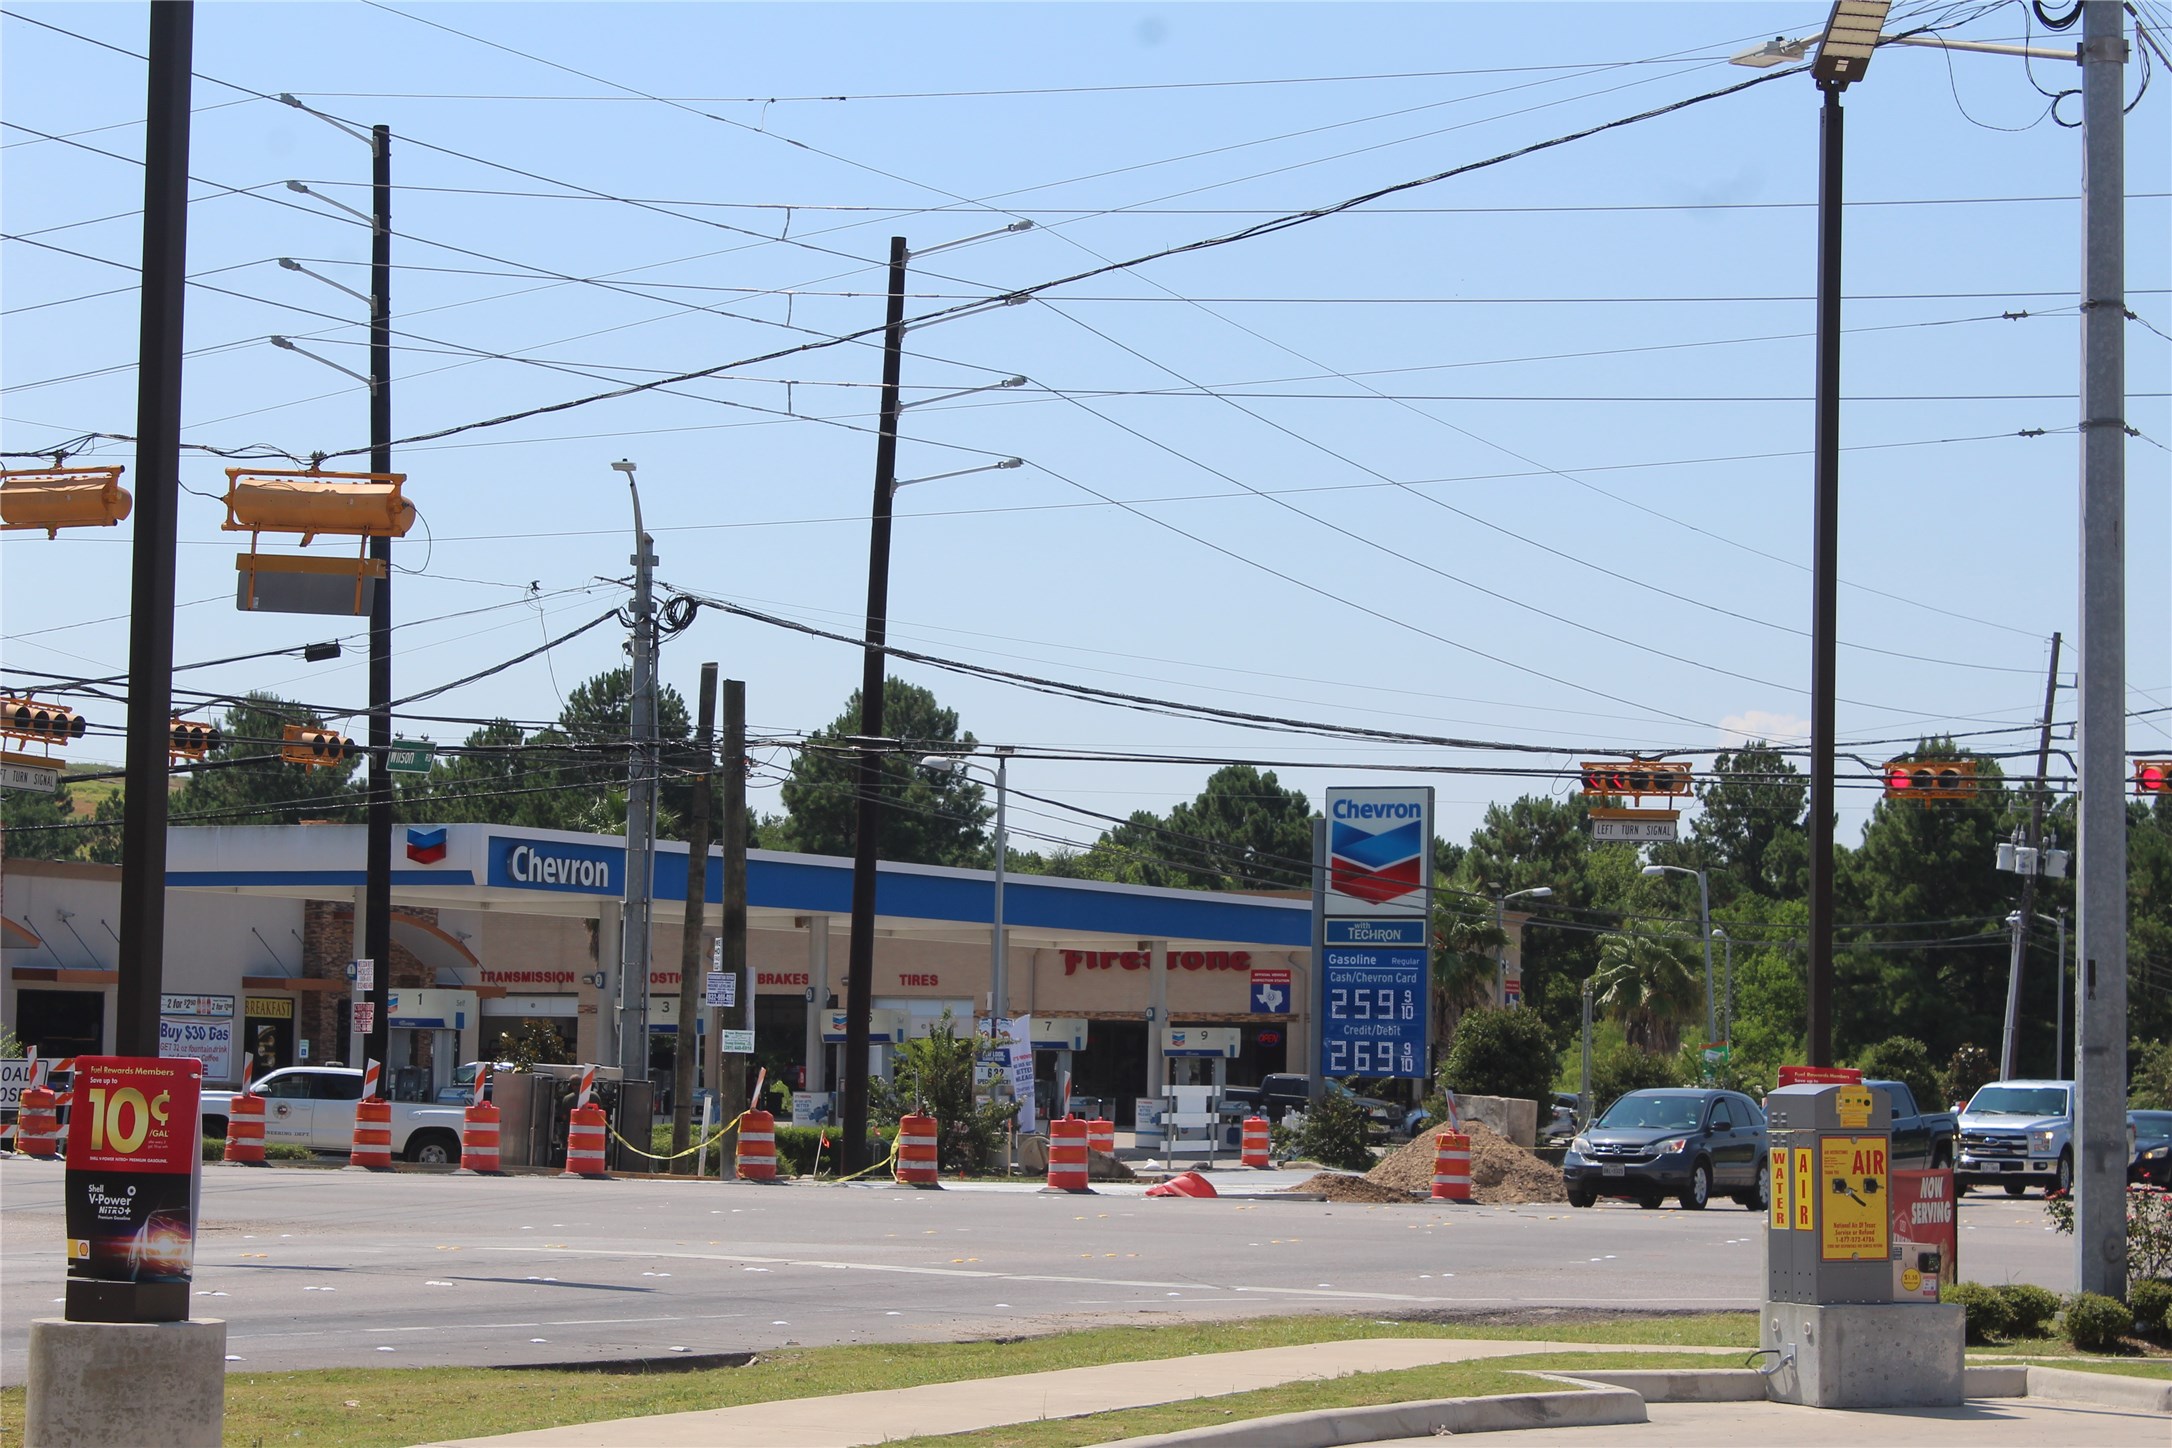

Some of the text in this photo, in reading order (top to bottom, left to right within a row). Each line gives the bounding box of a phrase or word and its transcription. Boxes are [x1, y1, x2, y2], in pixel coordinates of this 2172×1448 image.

[13, 770, 28, 782] TURN
[34, 773, 54, 787] SIGNAL
[1332, 799, 1422, 819] Chevron
[1597, 824, 1671, 836] LEFT TURN SIGNAL
[509, 845, 609, 888] Chevron
[1354, 922, 1371, 930] with
[1328, 953, 1420, 967] Gasoline Regular
[480, 971, 575, 983] TRANSMISSION
[650, 972, 682, 984] OSTI
[757, 973, 809, 984] BRAKES
[899, 974, 939, 986] TIRES
[1330, 971, 1417, 983] Cash/Chevron Card
[167, 999, 172, 1009] 2
[173, 999, 183, 1009] for
[418, 993, 423, 1006] 1
[1331, 989, 1394, 1020] 259
[245, 1000, 291, 1017] BREAKFAST
[661, 1001, 670, 1013] 3
[160, 1022, 229, 1042] Buy $30 Gas
[1045, 1021, 1052, 1031] 7
[1343, 1024, 1401, 1036] Credit/Debit
[1200, 1030, 1208, 1041] 9
[1258, 1032, 1279, 1043] OPEN
[160, 1042, 173, 1051] GET
[188, 1044, 212, 1053] fountain
[212, 1045, 228, 1053] drink
[201, 1053, 219, 1062] Coffee
[1330, 1040, 1394, 1072] 269
[90, 1066, 175, 1077] Fuel Rewards Members
[89, 1087, 171, 1154] 10¢
[1852, 1150, 1885, 1175] AIR
[88, 1184, 104, 1193] Shell
[1773, 1152, 1786, 1224] WATER
[1799, 1153, 1809, 1225] AIR
[1920, 1176, 1944, 1198] NOW
[88, 1194, 132, 1206] V-Power
[1911, 1201, 1952, 1225] SERVING
